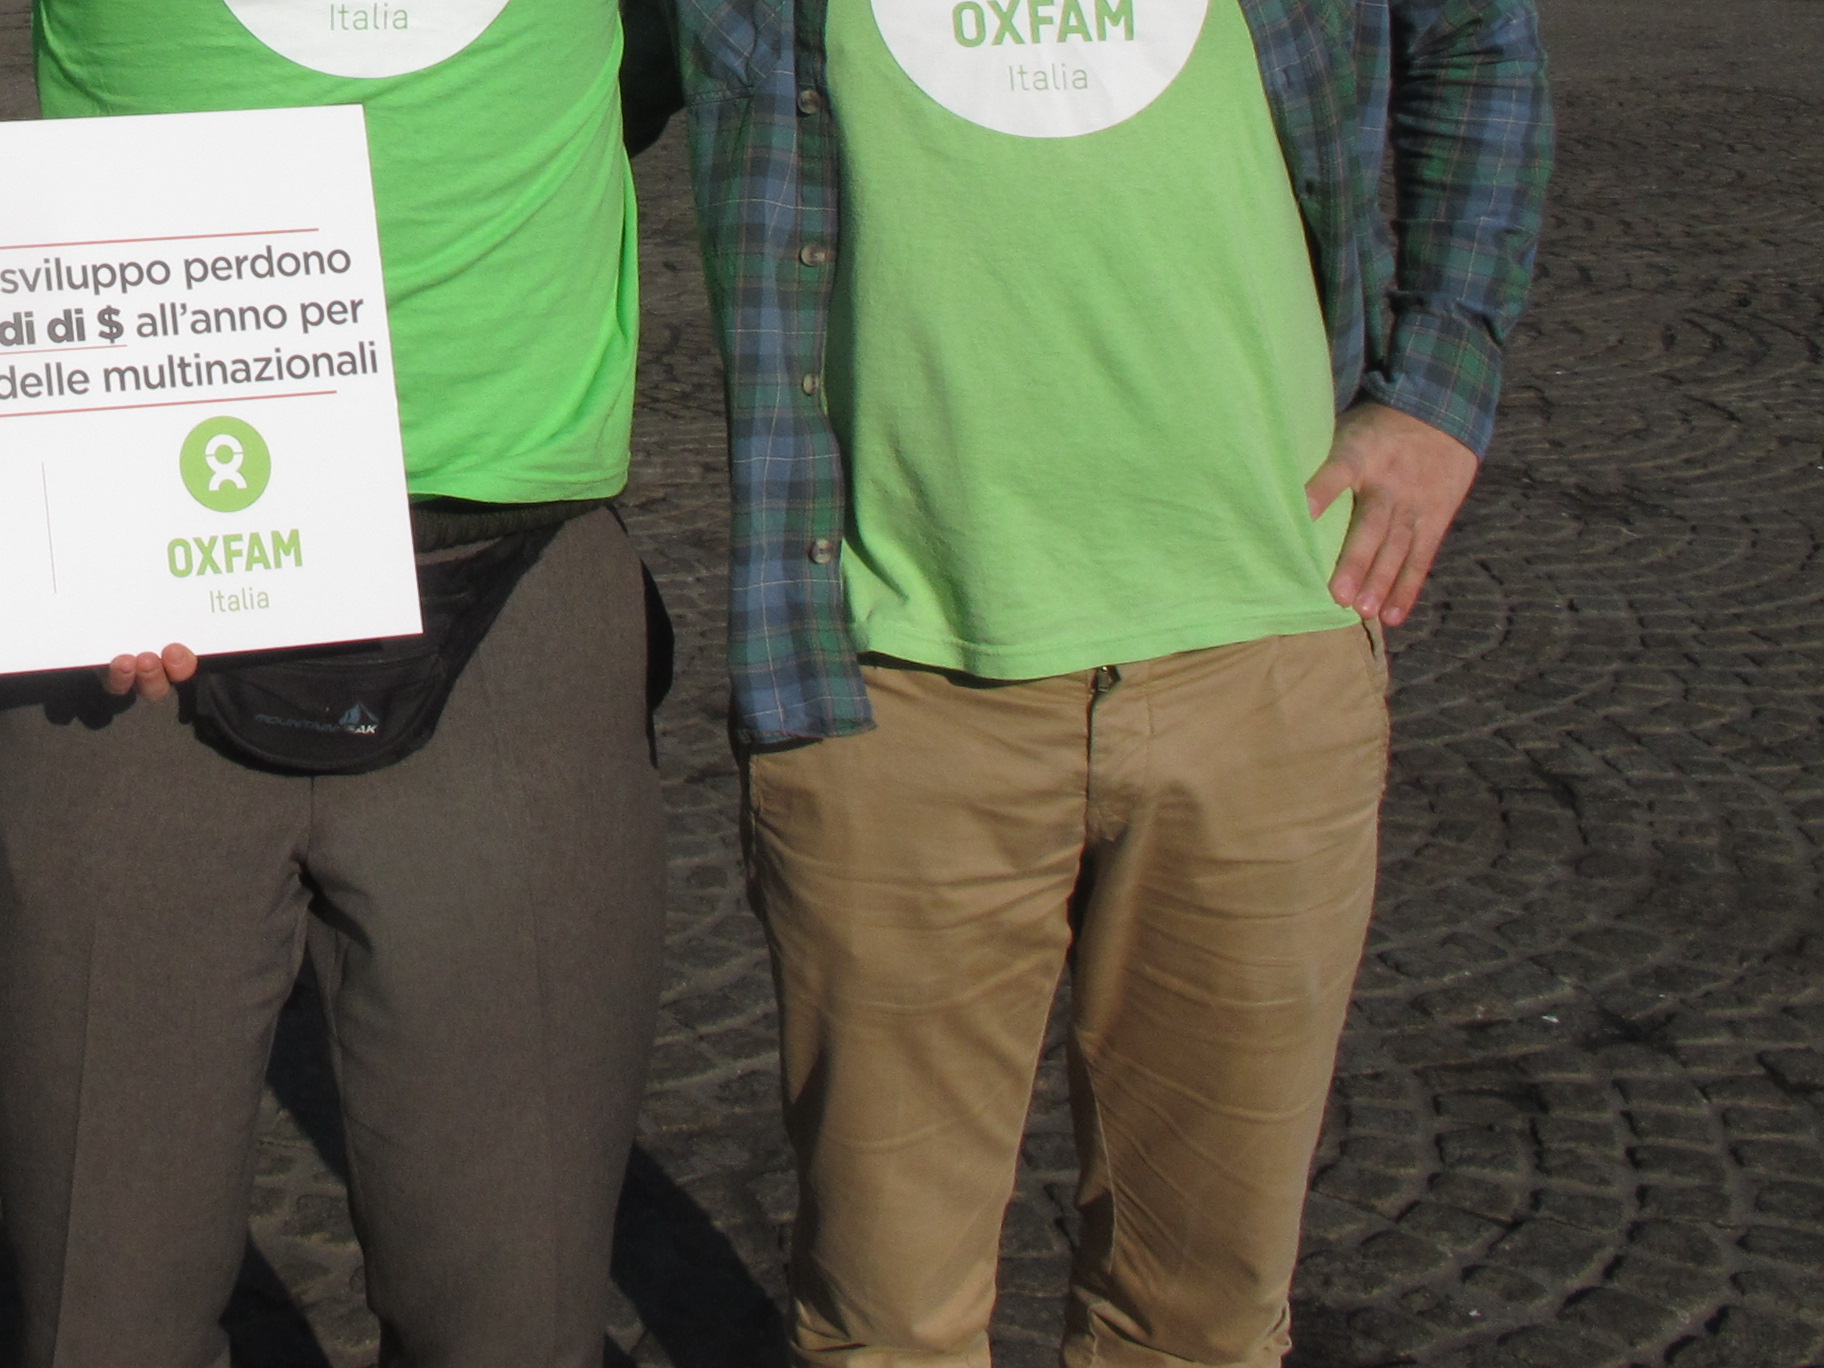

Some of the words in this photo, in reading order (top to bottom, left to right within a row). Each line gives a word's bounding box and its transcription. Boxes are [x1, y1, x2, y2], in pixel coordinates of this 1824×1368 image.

[329, 2, 409, 31] Italia
[1007, 62, 1089, 91] Italia
[182, 243, 353, 292] perdono
[45, 306, 88, 345] di
[95, 303, 126, 346] $
[299, 297, 365, 336] per
[102, 339, 379, 394] multinazionali
[167, 528, 304, 579] OXFAM
[207, 587, 272, 615] Italia
